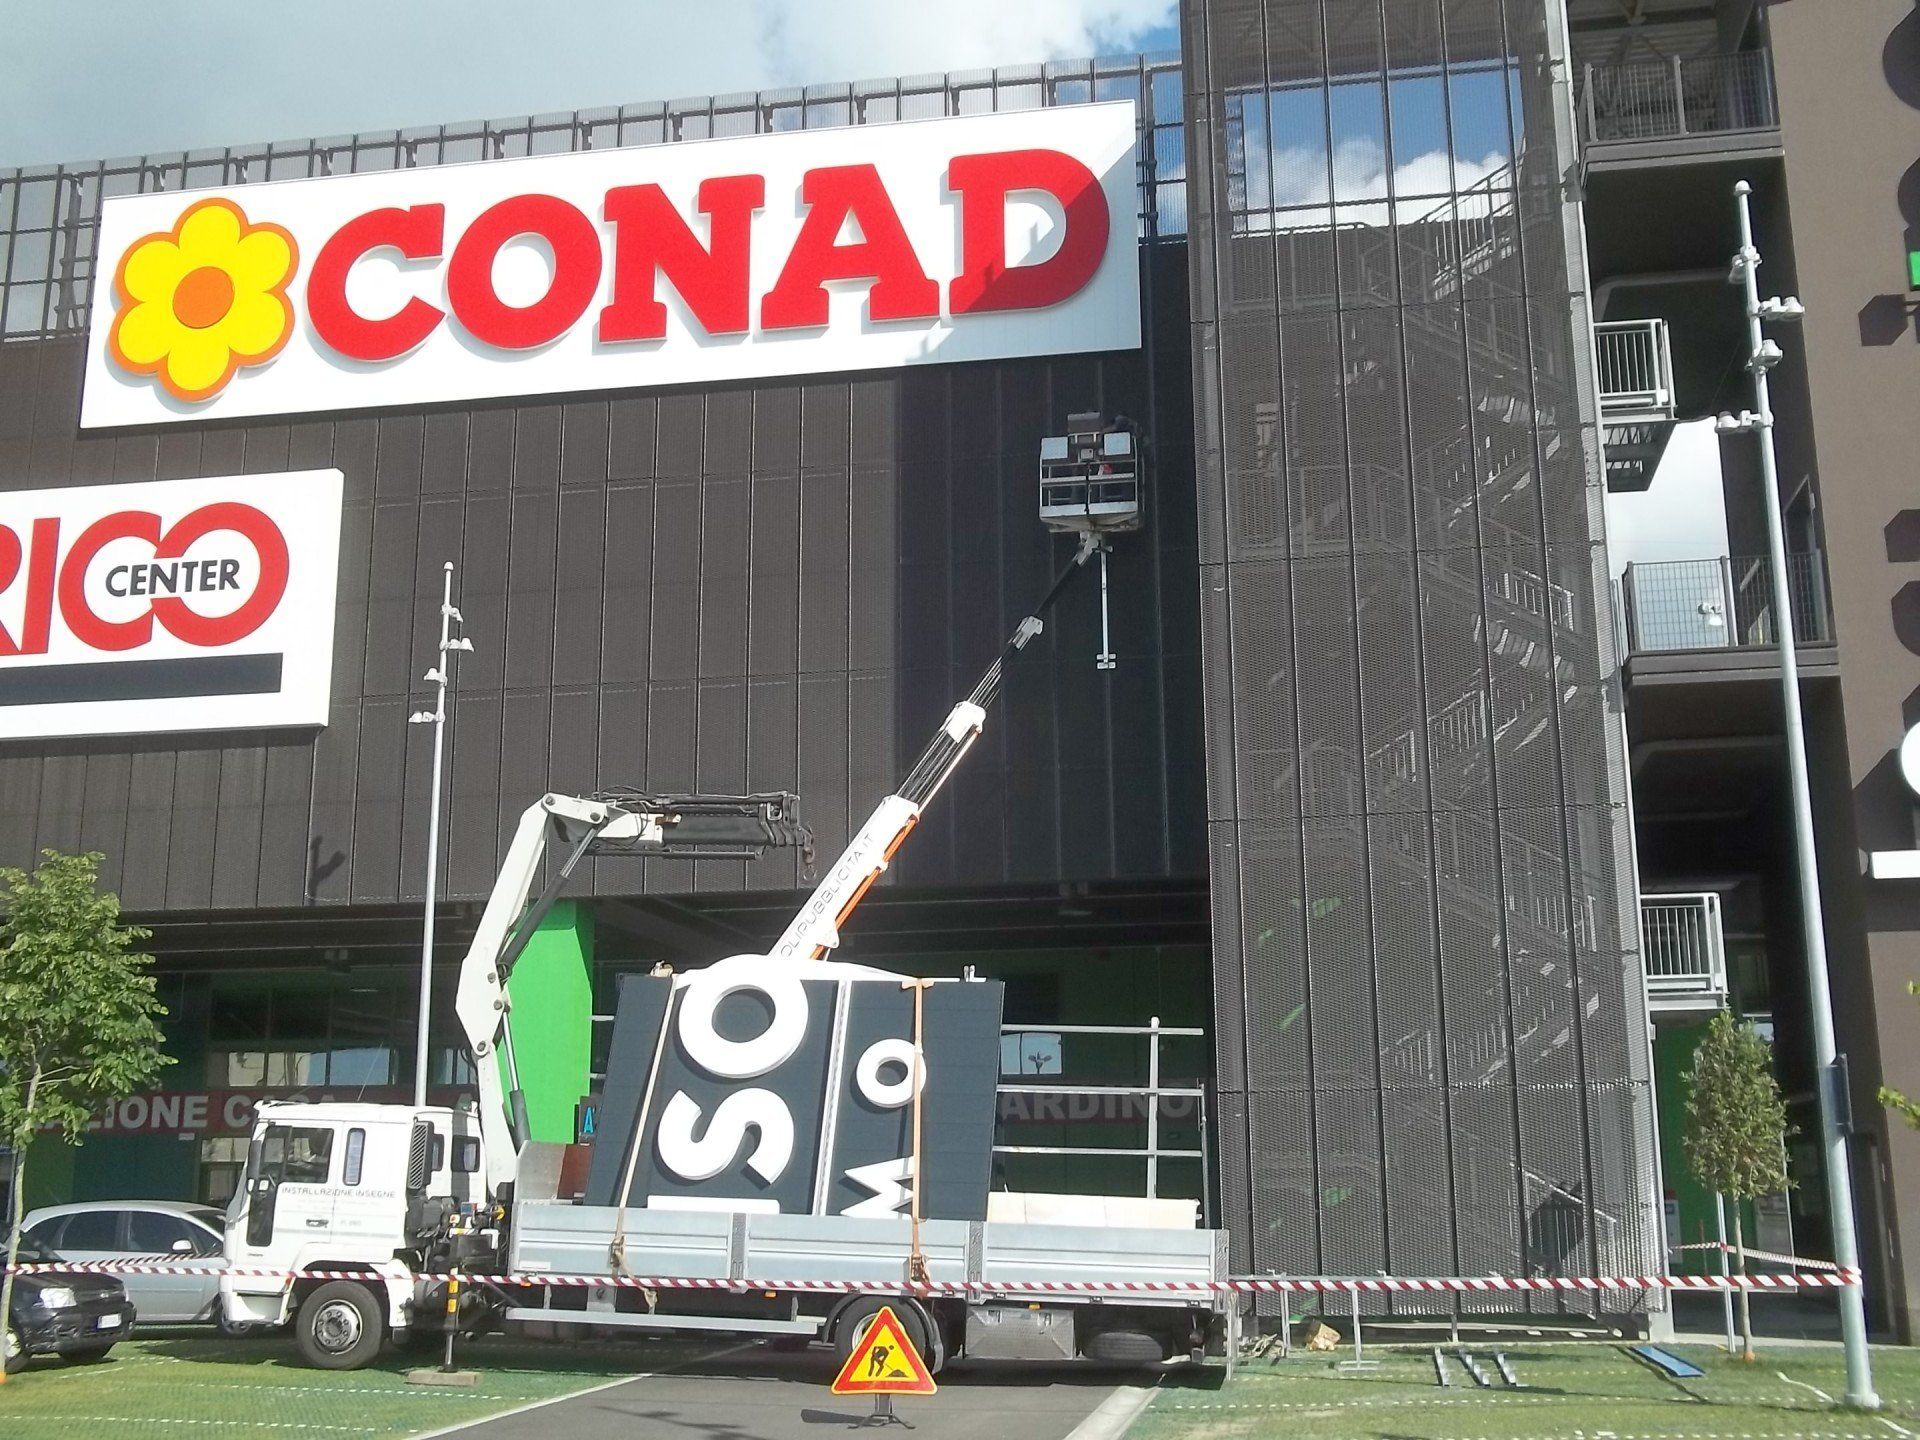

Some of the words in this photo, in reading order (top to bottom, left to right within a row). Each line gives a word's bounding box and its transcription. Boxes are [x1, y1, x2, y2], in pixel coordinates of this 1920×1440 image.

[307, 148, 1110, 361] CONAD
[105, 558, 240, 598] CENTER
[281, 1186, 353, 1197] INSTALLAZIONE
[355, 1189, 397, 1199] INSEGNE
